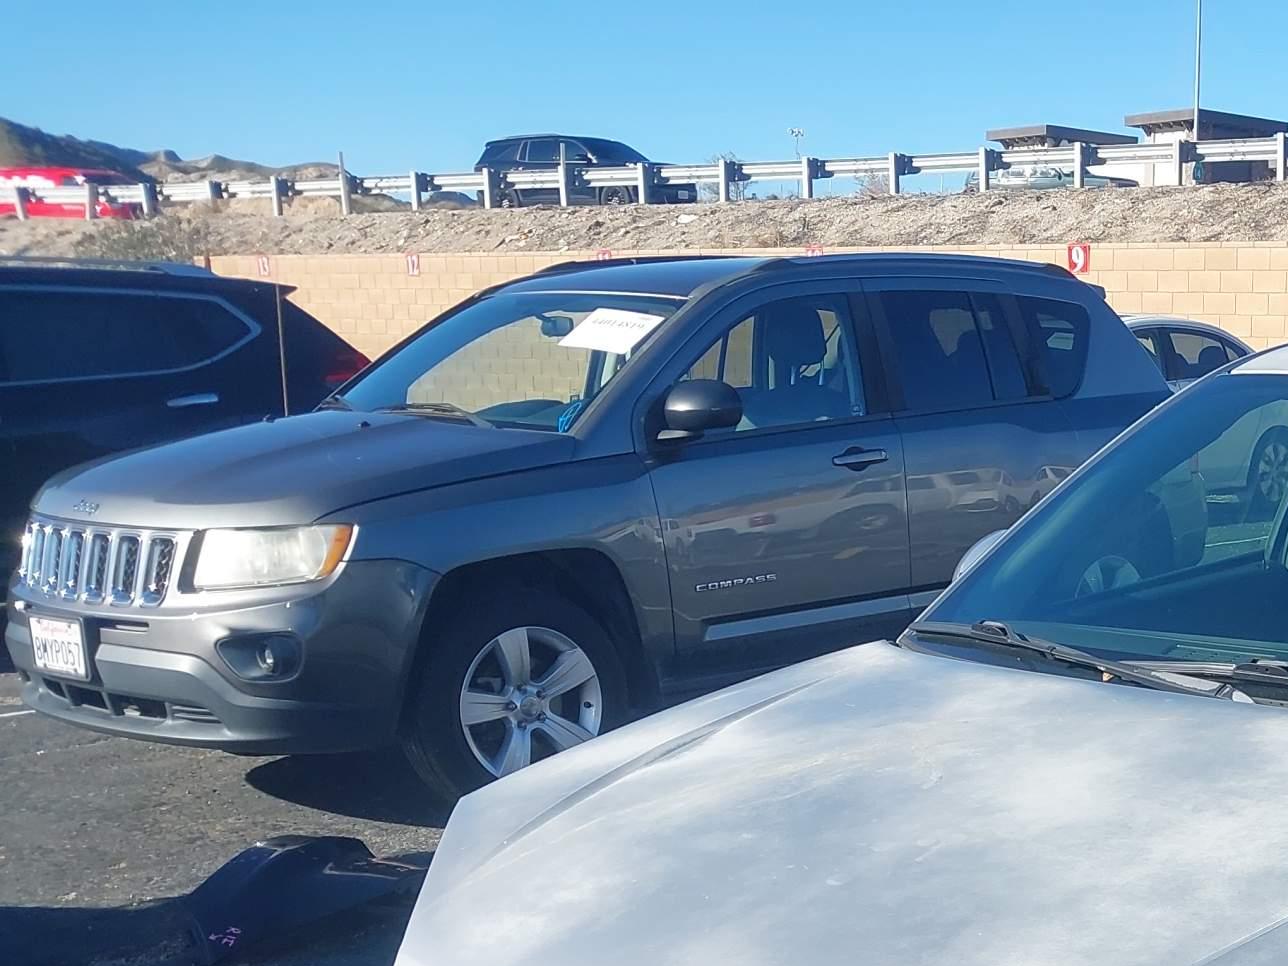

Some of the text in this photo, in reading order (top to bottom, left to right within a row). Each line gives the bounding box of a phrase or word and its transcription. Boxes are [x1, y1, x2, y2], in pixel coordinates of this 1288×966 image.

[407, 255, 419, 275] 12
[1071, 246, 1085, 272] 9
[695, 573, 777, 592] COMPASS
